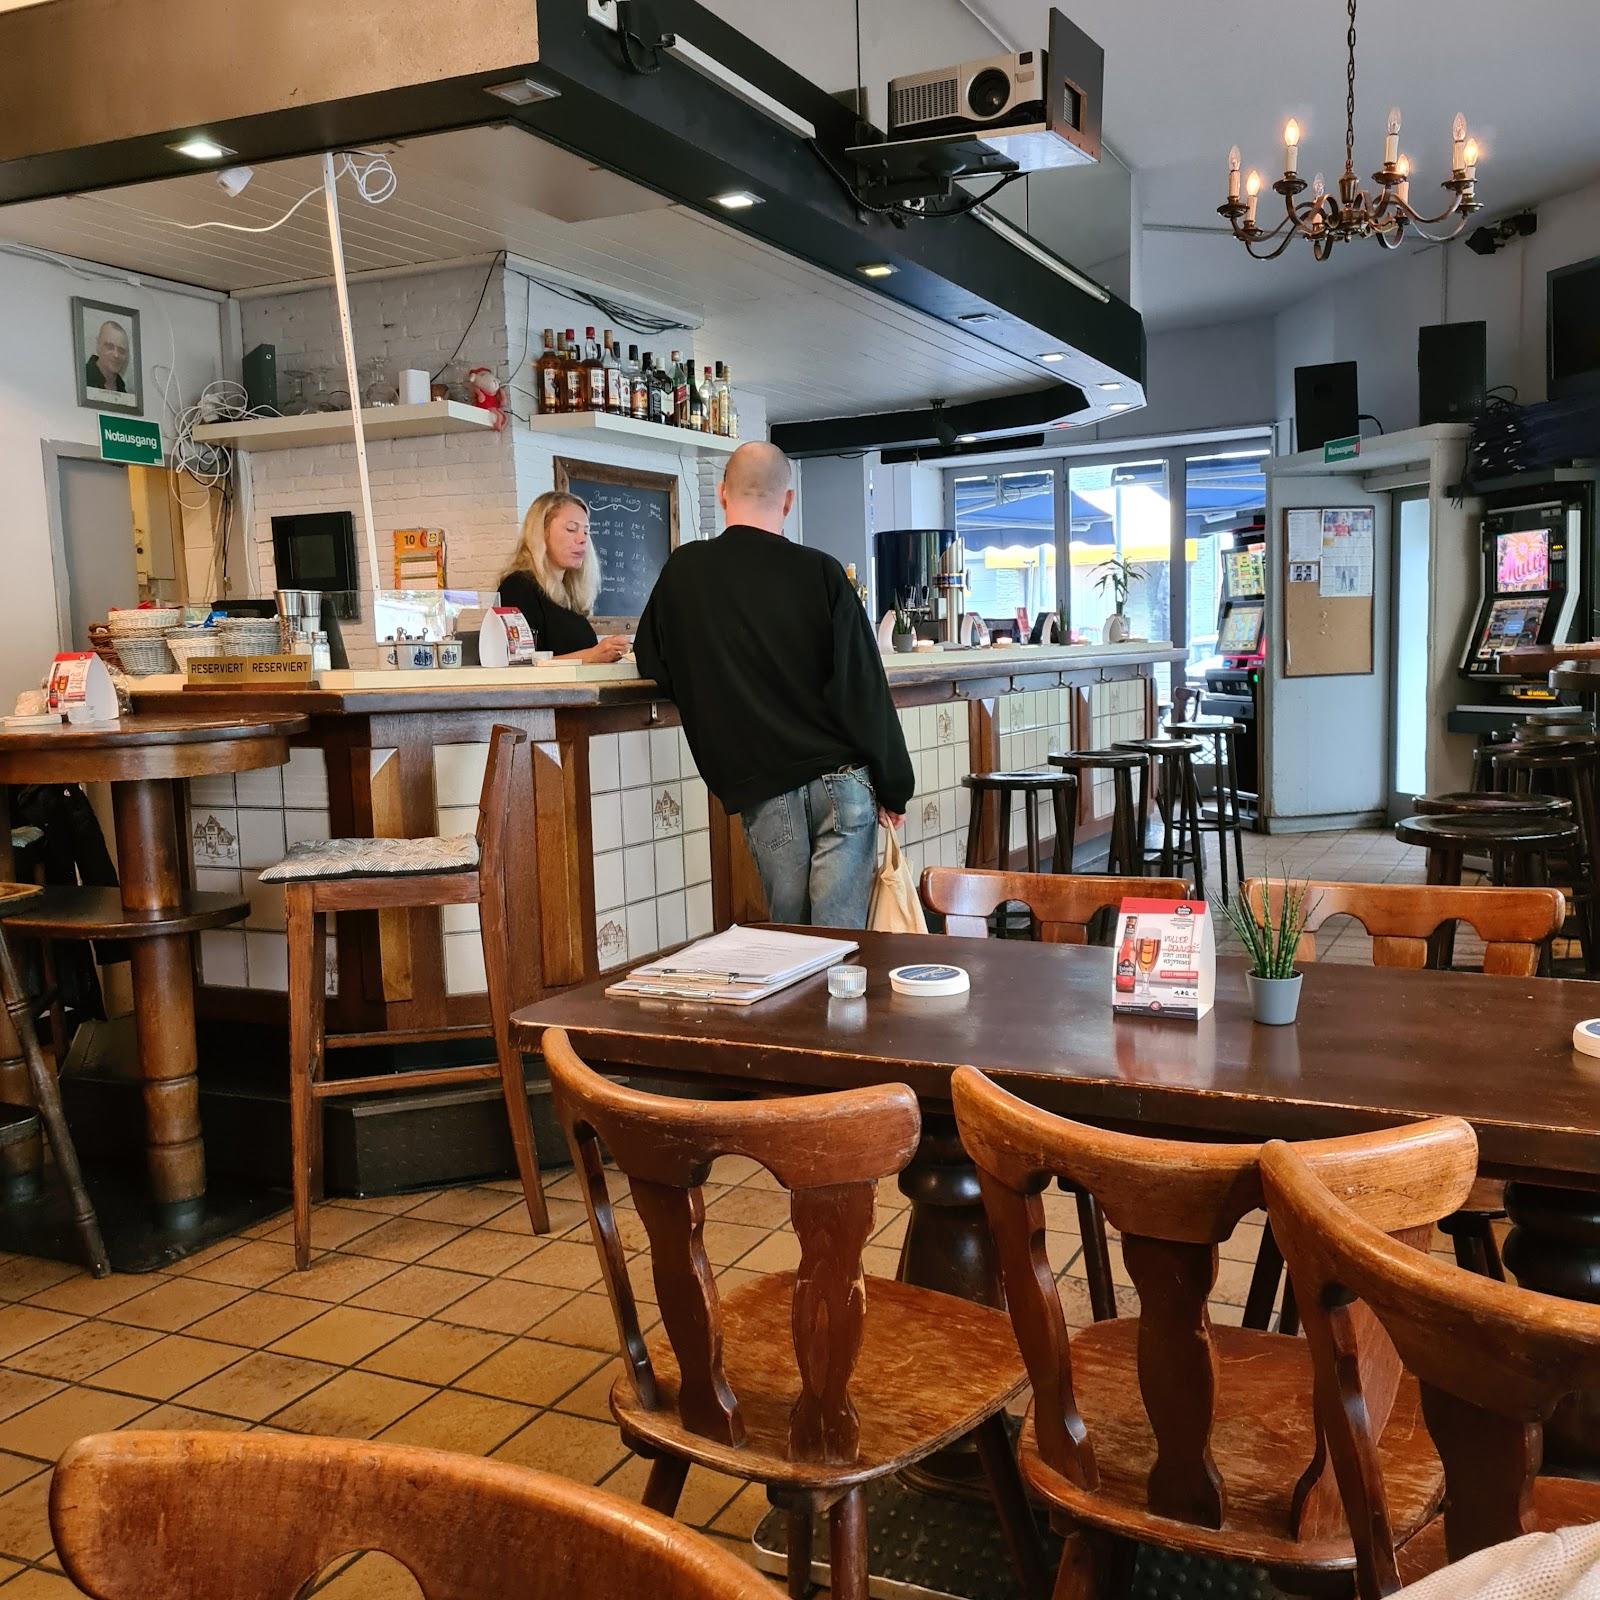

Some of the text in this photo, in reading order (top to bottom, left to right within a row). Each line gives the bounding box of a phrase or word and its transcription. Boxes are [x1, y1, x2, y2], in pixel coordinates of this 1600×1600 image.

[104, 428, 157, 449] Notausgang
[404, 534, 416, 546] 10
[191, 663, 243, 674] RESERVIERT
[252, 661, 308, 673] RESERVIERT
